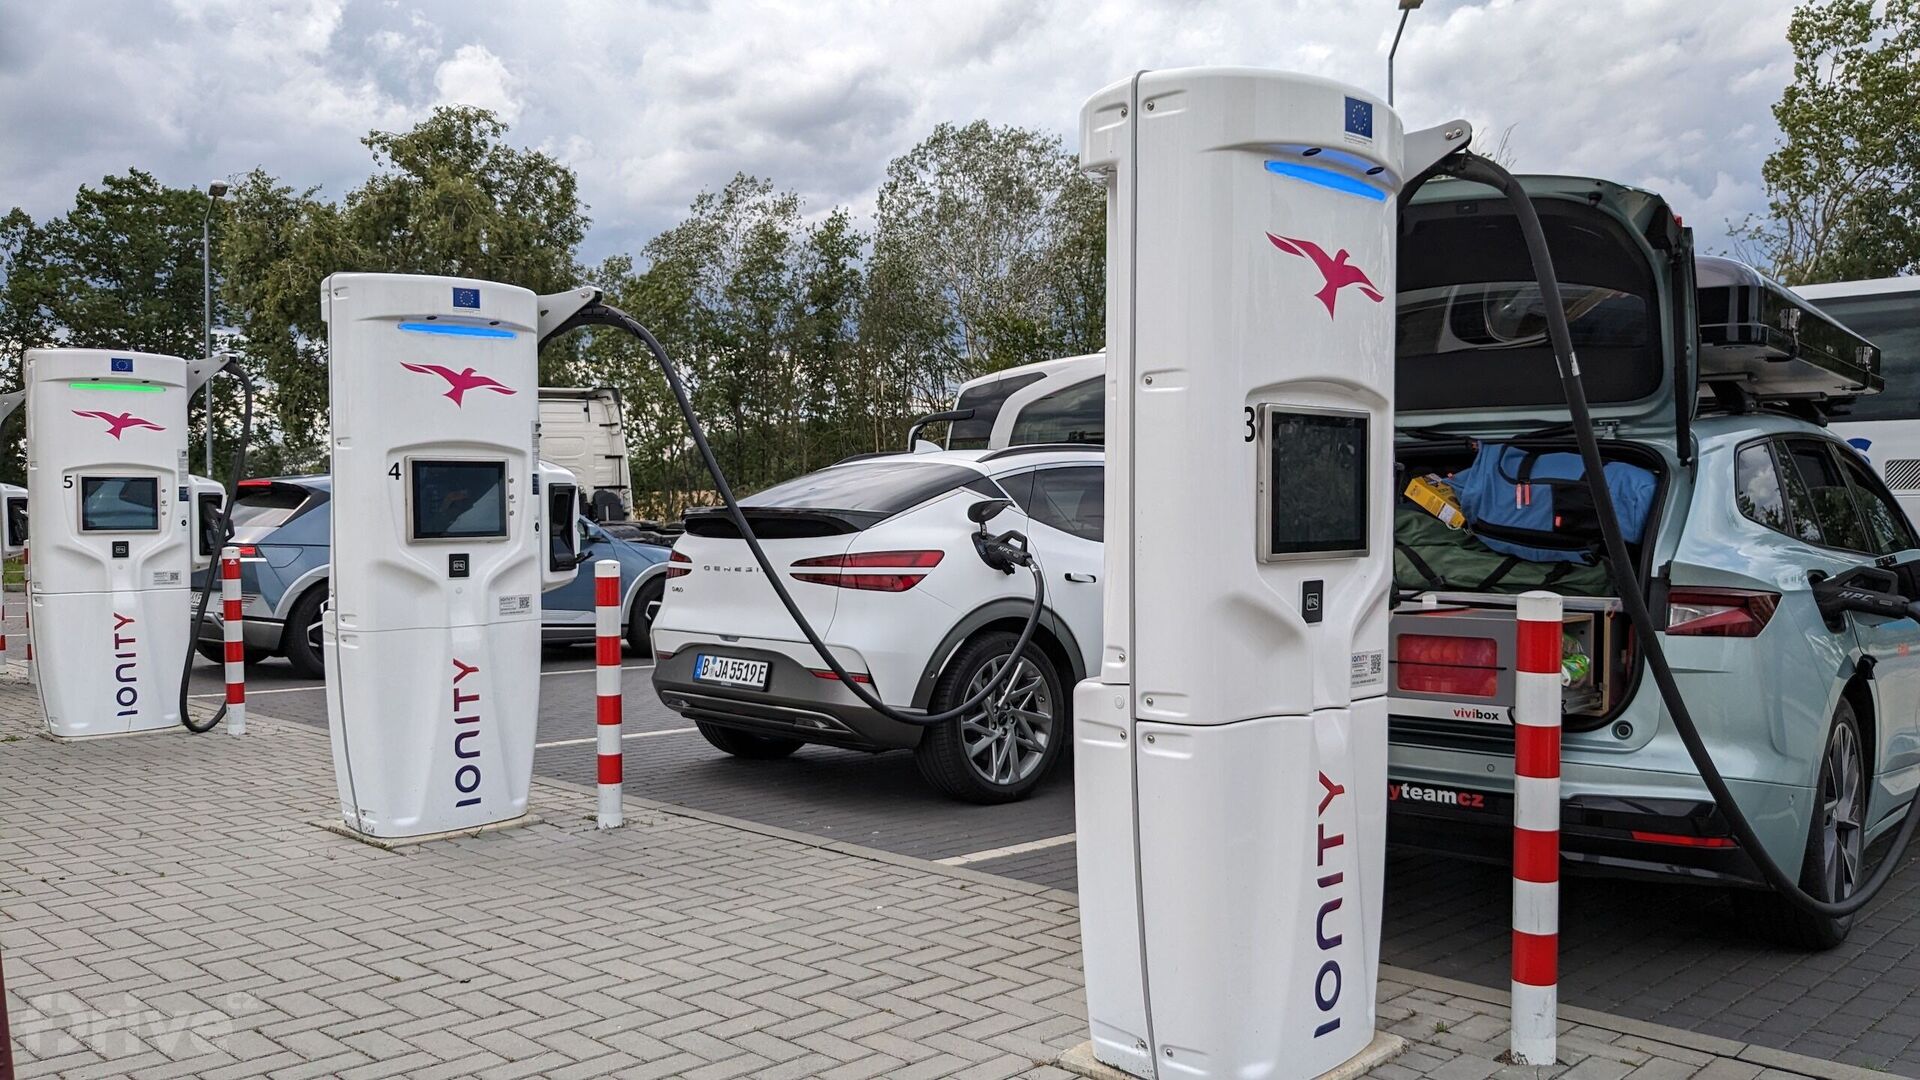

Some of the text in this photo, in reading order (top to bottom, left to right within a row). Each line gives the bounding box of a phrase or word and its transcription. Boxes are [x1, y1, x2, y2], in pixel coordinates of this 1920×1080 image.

[1244, 406, 1257, 443] 3
[388, 462, 402, 481] 4
[63, 475, 74, 489] 5
[703, 564, 767, 573] GENESI
[1837, 590, 1875, 602] HPC
[113, 613, 137, 717] IONITY
[701, 658, 711, 676] B
[1453, 707, 1500, 721] vivibox
[453, 659, 481, 808] IONITY
[1314, 771, 1345, 1038] IONITY
